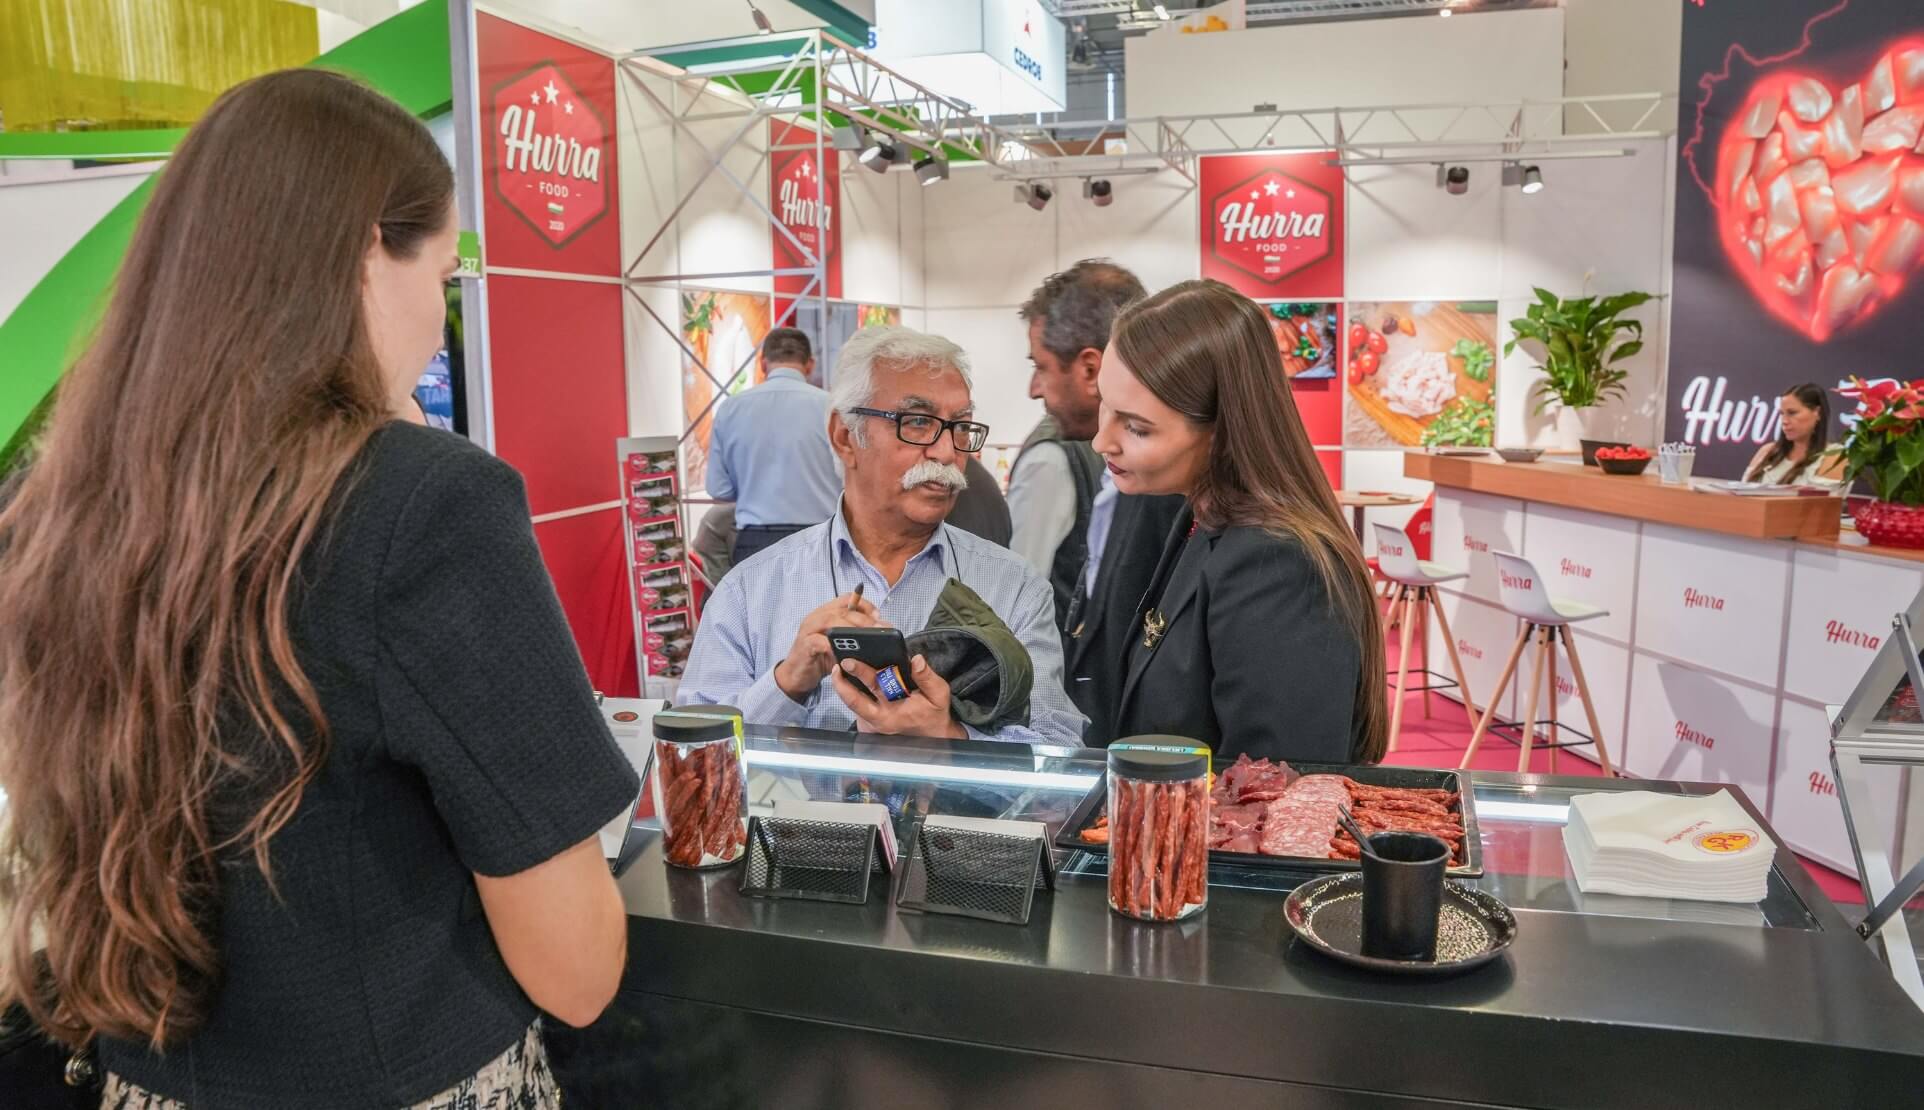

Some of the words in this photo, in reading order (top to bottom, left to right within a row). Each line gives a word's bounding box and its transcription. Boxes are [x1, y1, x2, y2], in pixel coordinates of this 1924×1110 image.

[500, 104, 601, 183] Hurra
[539, 181, 569, 199] FOOD
[1219, 201, 1325, 242] Hurra
[1255, 243, 1287, 252] FOOD
[1463, 535, 1488, 552] Hurra
[1560, 557, 1592, 578] Hurra
[1500, 569, 1532, 590] Hurra
[1683, 587, 1725, 611] Hurra
[1825, 619, 1880, 651] Hurra
[1458, 639, 1483, 659] Hurra
[1556, 675, 1582, 697] Hurr
[1674, 720, 1715, 750] Hurra
